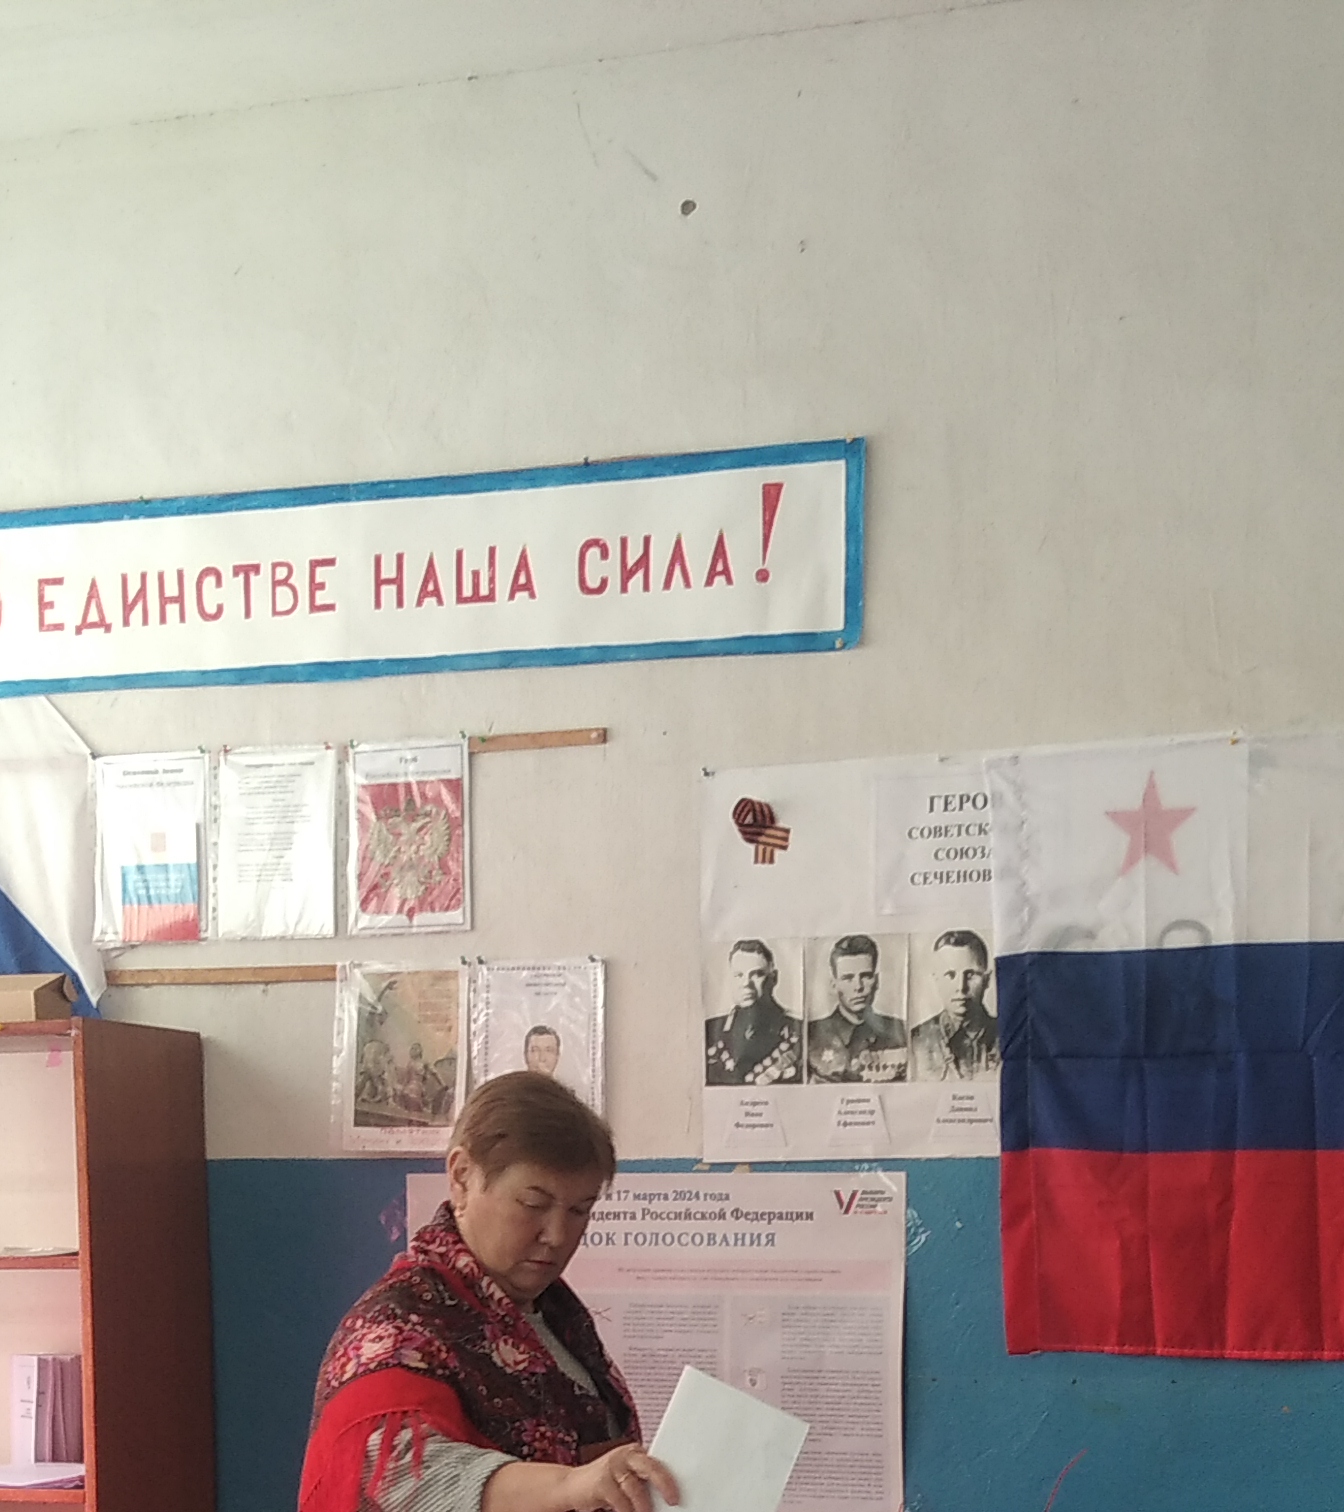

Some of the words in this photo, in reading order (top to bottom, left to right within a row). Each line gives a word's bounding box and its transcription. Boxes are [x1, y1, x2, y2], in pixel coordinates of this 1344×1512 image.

[37, 557, 337, 636] ЕДИНСТВЕ
[373, 543, 538, 610] НАША
[576, 482, 786, 597] СИЛА!
[927, 791, 989, 814] ГЕРО
[906, 822, 991, 841] СОВЕТСК
[909, 868, 993, 887] СЕЧЕНОВ
[616, 1189, 630, 1202] 17
[632, 1191, 669, 1205] марта
[671, 1190, 701, 1202] 2024
[703, 1192, 731, 1203] года
[640, 1207, 727, 1222] Российской
[730, 1207, 815, 1226] Федерации
[623, 1231, 777, 1248] ГОЛОСОВАНИЯ
